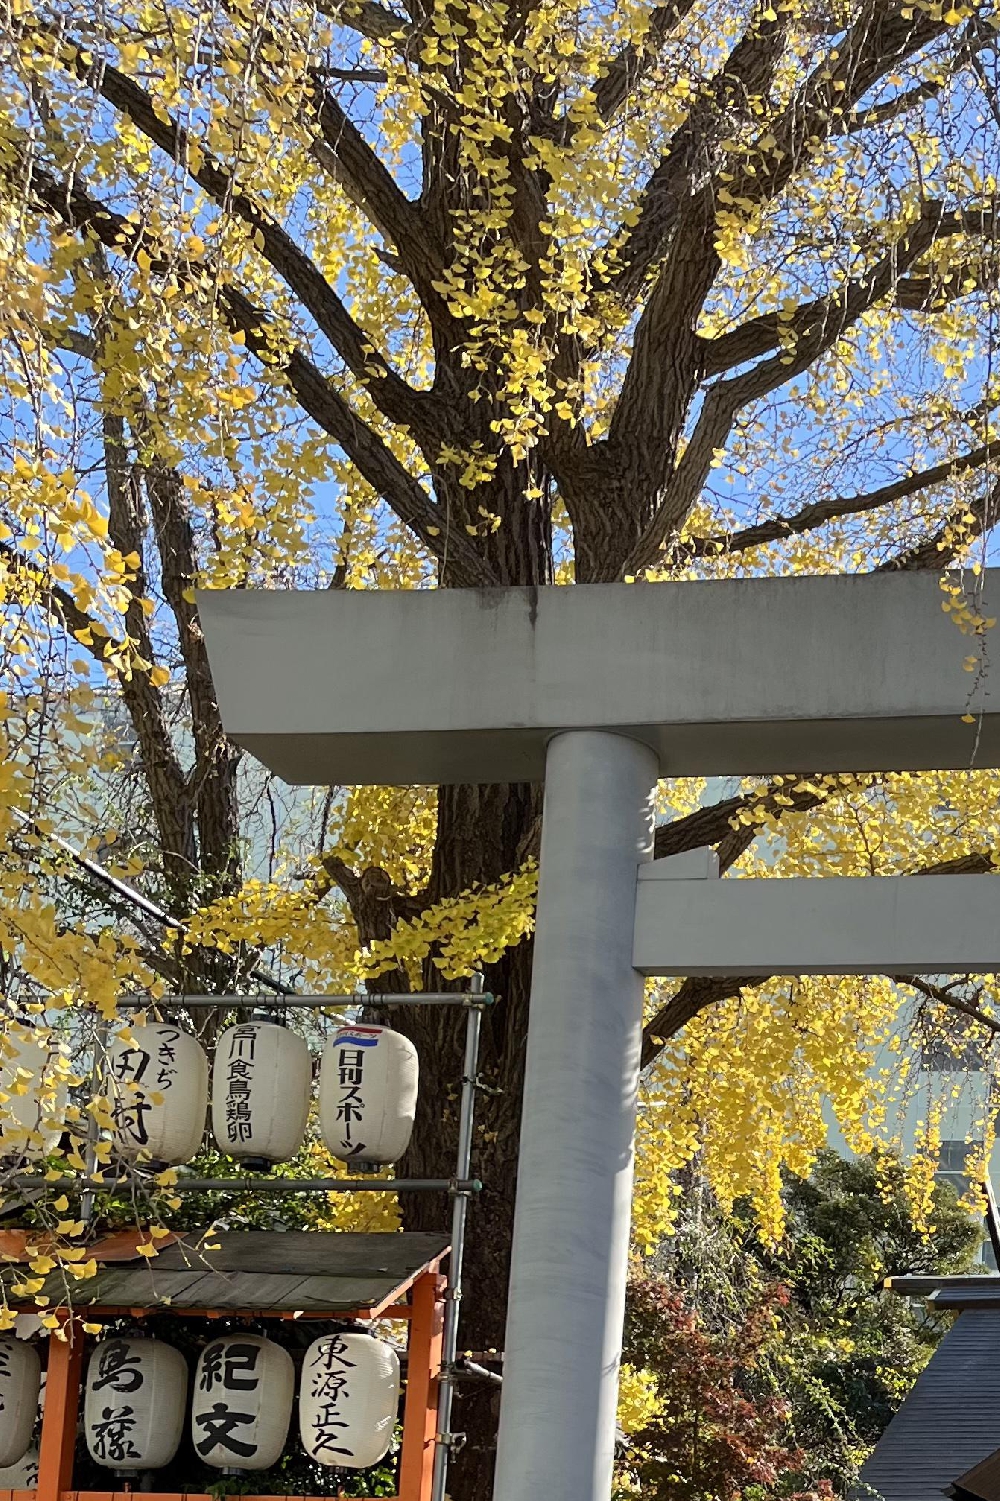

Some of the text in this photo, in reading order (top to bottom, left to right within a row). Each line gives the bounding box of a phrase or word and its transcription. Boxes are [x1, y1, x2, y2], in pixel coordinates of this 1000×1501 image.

[156, 1029, 180, 1090] つきぢ
[226, 1025, 260, 1143] 宮川食鳥鶏卵
[336, 1049, 366, 1156] 日刊スポーツ
[195, 1343, 262, 1458] 紀文
[310, 1335, 357, 1457] 東源正久
